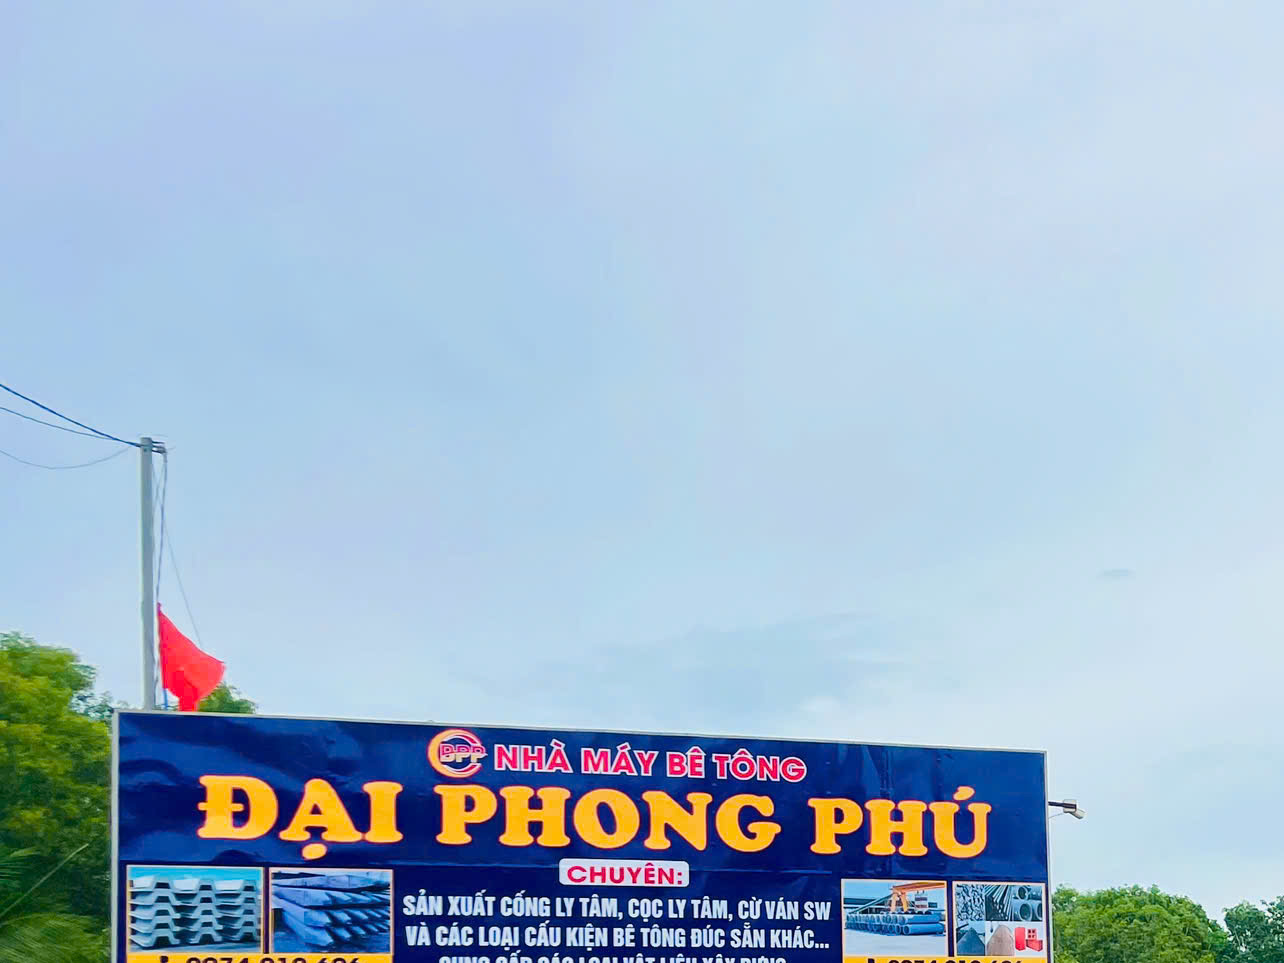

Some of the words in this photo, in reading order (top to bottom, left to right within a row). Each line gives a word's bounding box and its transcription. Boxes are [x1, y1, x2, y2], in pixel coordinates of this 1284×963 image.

[494, 739, 573, 773] NHÀ
[581, 743, 657, 777] MÁY
[666, 747, 705, 778] BÊ
[713, 749, 807, 783] TÔNG
[197, 774, 404, 860] ĐẠI
[434, 784, 781, 853] PHONG
[808, 786, 992, 858] PHÚ
[567, 862, 683, 885] CHUYÊN:
[403, 889, 443, 916] SẢN
[447, 889, 496, 916] XUẤT
[500, 890, 551, 917] CỐNG
[555, 897, 575, 917] LY
[579, 893, 623, 920] TÂM,
[628, 898, 663, 922] CỌC
[668, 899, 687, 919] LY
[691, 896, 733, 921] TÂM,
[738, 897, 762, 920] CỪ
[765, 897, 799, 920] VÁN
[804, 901, 831, 920] SW
[405, 922, 431, 946] VÀ
[435, 922, 474, 946] CÁC
[478, 926, 520, 951] LOẠI
[524, 920, 561, 947] CẤU
[566, 923, 608, 951] KIỆN
[613, 924, 635, 947] BÊ
[640, 924, 686, 948] TÔNG
[690, 925, 725, 948] ĐÚC
[730, 922, 765, 948] SẴN
[770, 926, 830, 949] KHÁC...
